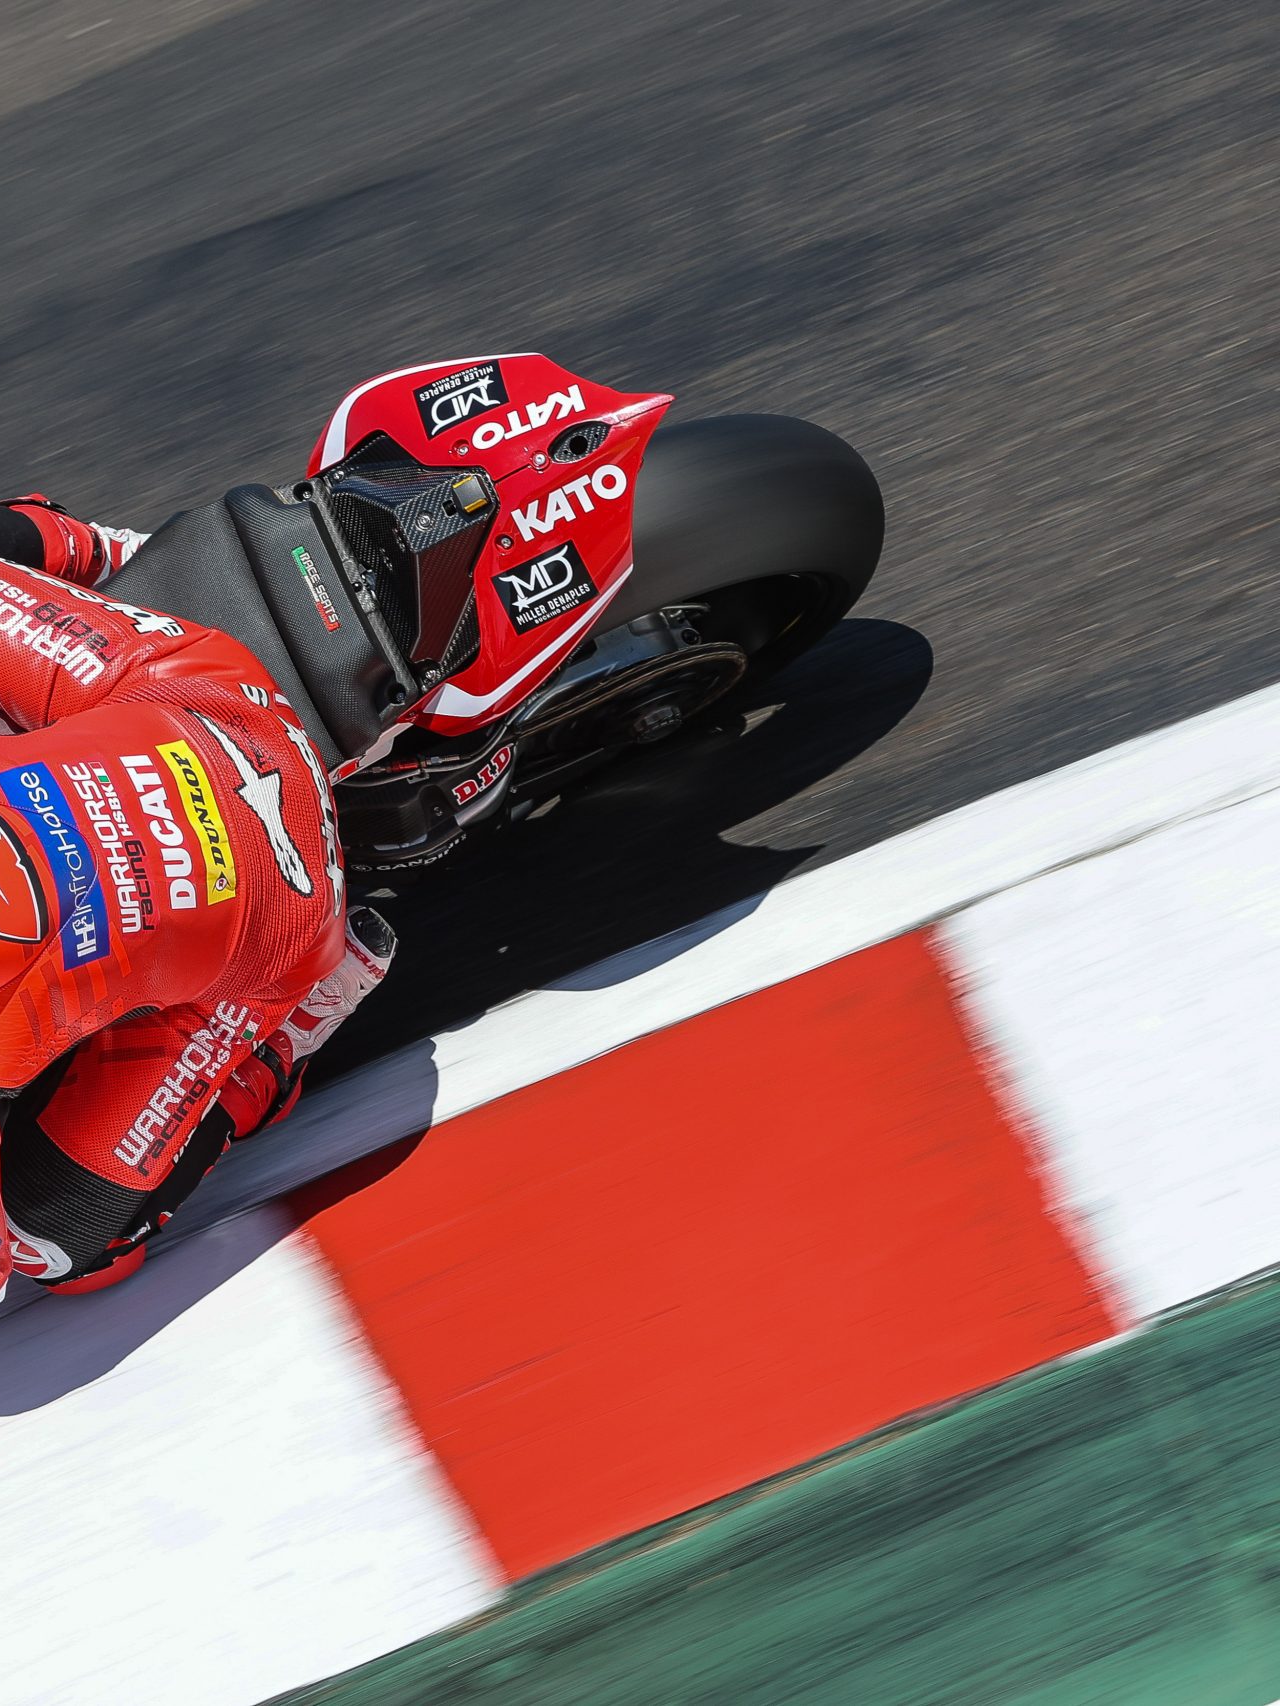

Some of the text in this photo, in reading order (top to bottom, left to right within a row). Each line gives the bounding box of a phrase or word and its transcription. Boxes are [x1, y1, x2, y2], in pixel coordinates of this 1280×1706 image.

[420, 365, 494, 401] MILLER DENAPLES
[472, 384, 587, 450] KATO
[511, 464, 627, 542] KATO
[300, 552, 339, 623] RACE SEATS
[516, 583, 590, 625] MILLER DENAPLES
[535, 608, 561, 625] BUCKING
[62, 762, 143, 934] WARHORSE
[120, 754, 197, 910] DUCATI
[169, 751, 228, 868] DUNLOP
[104, 783, 155, 931] racing HSBK
[113, 1000, 248, 1167] WARHORSE
[137, 1079, 209, 1177] racing
